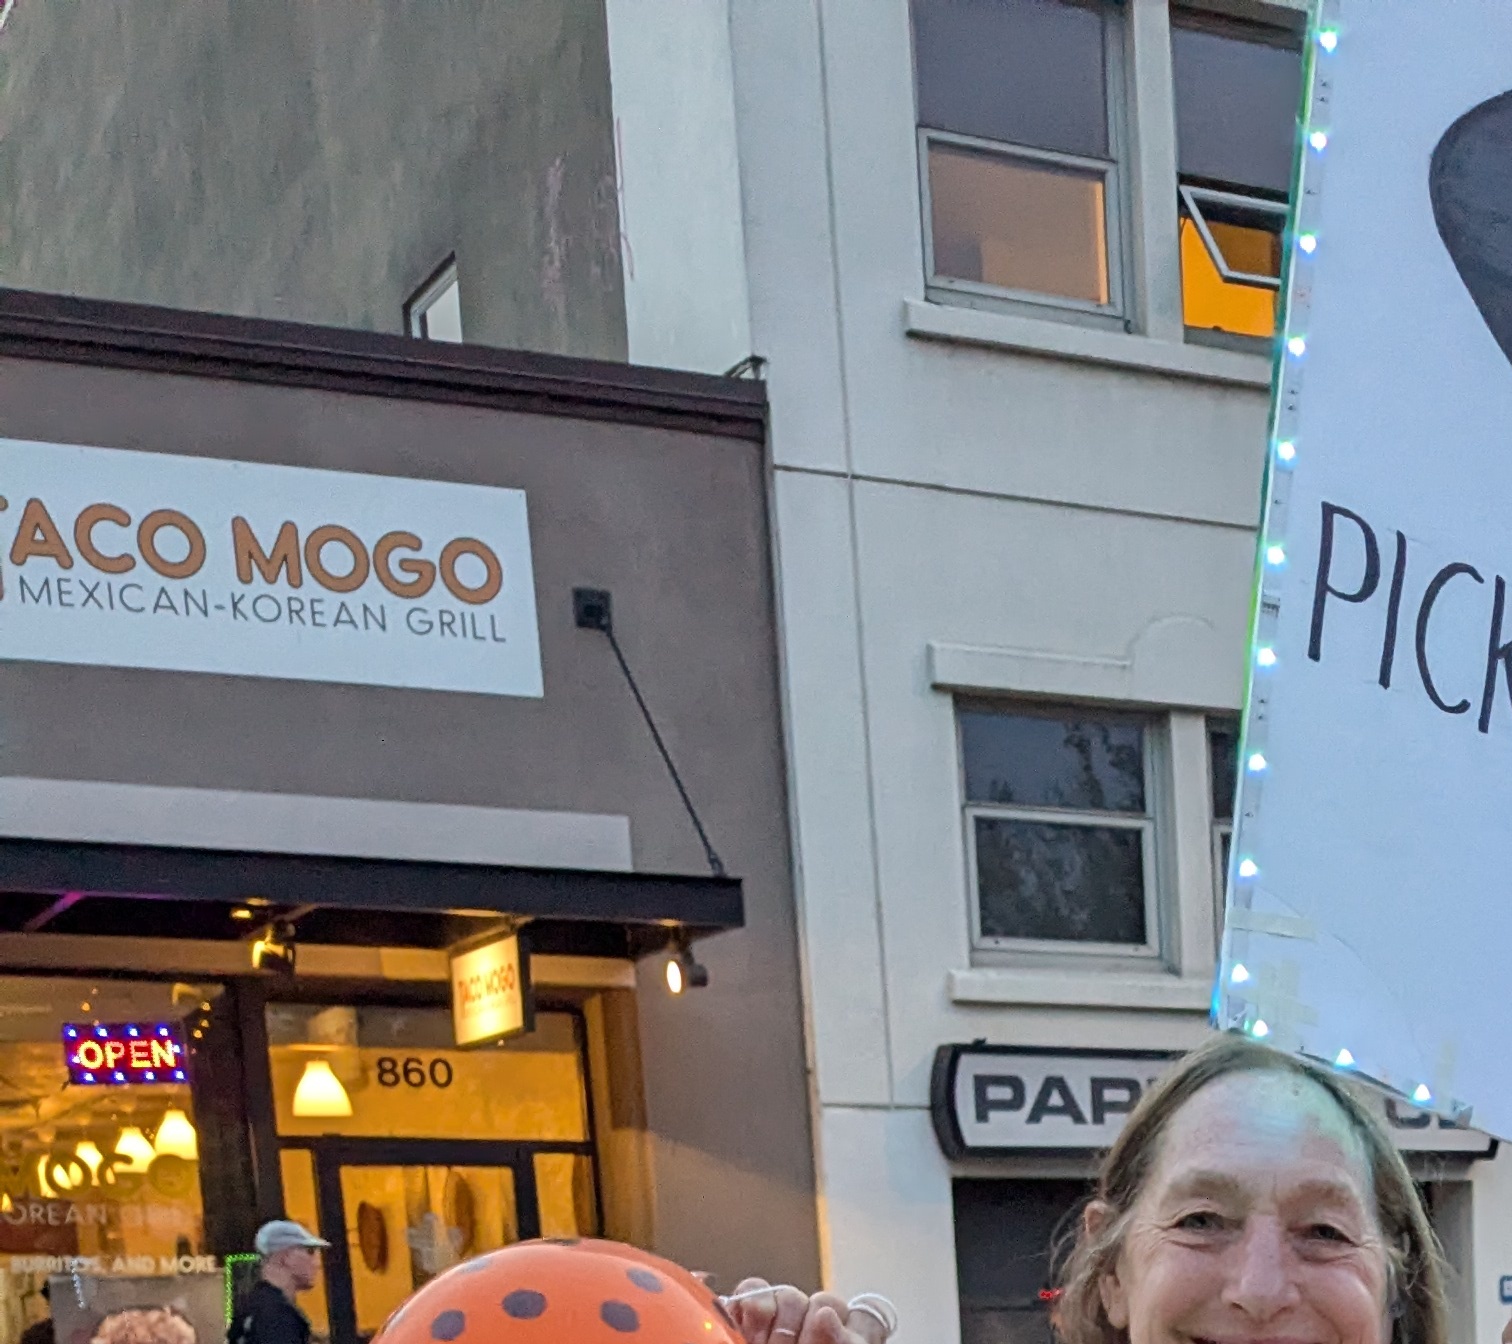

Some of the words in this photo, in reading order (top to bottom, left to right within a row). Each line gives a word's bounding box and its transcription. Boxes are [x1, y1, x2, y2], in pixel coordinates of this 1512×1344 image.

[231, 515, 503, 606] MOGO
[19, 575, 387, 633] MEXICAN-KOREAN
[406, 607, 506, 643] GRILL
[77, 1039, 176, 1069] OPEN
[377, 1056, 453, 1089] 860
[111, 1255, 156, 1274] AND
